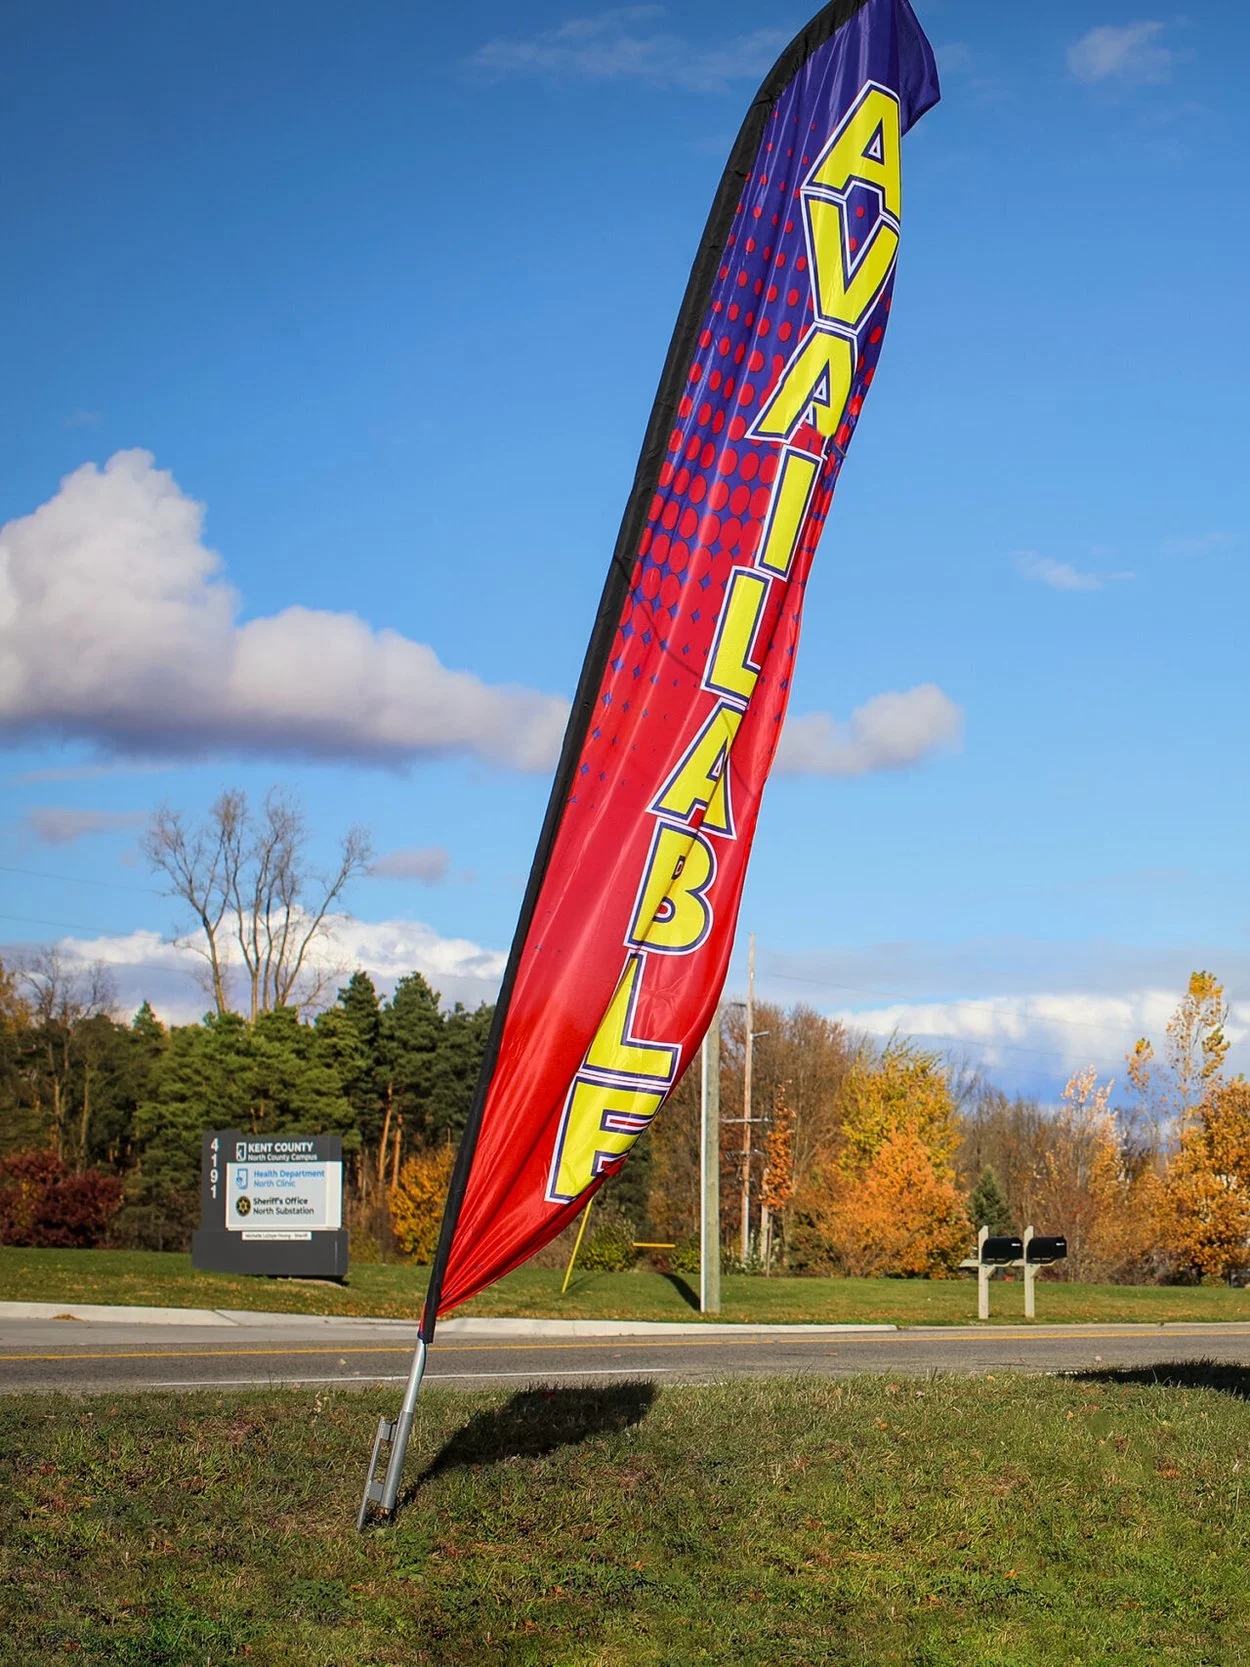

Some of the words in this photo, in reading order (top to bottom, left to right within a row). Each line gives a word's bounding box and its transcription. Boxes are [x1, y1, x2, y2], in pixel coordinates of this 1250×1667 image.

[248, 1143, 273, 1153] KENT
[274, 1142, 314, 1152] COUNTY
[267, 1154, 290, 1162] County
[291, 1153, 318, 1162] Campus
[210, 1137, 219, 1199] 4191
[254, 1170, 278, 1178] Health
[280, 1170, 325, 1179] Department
[276, 1180, 296, 1188] Clinic
[253, 1197, 283, 1205] Sheriff's
[285, 1197, 308, 1205] Office
[253, 1207, 274, 1215] North
[276, 1207, 315, 1215] Substation
